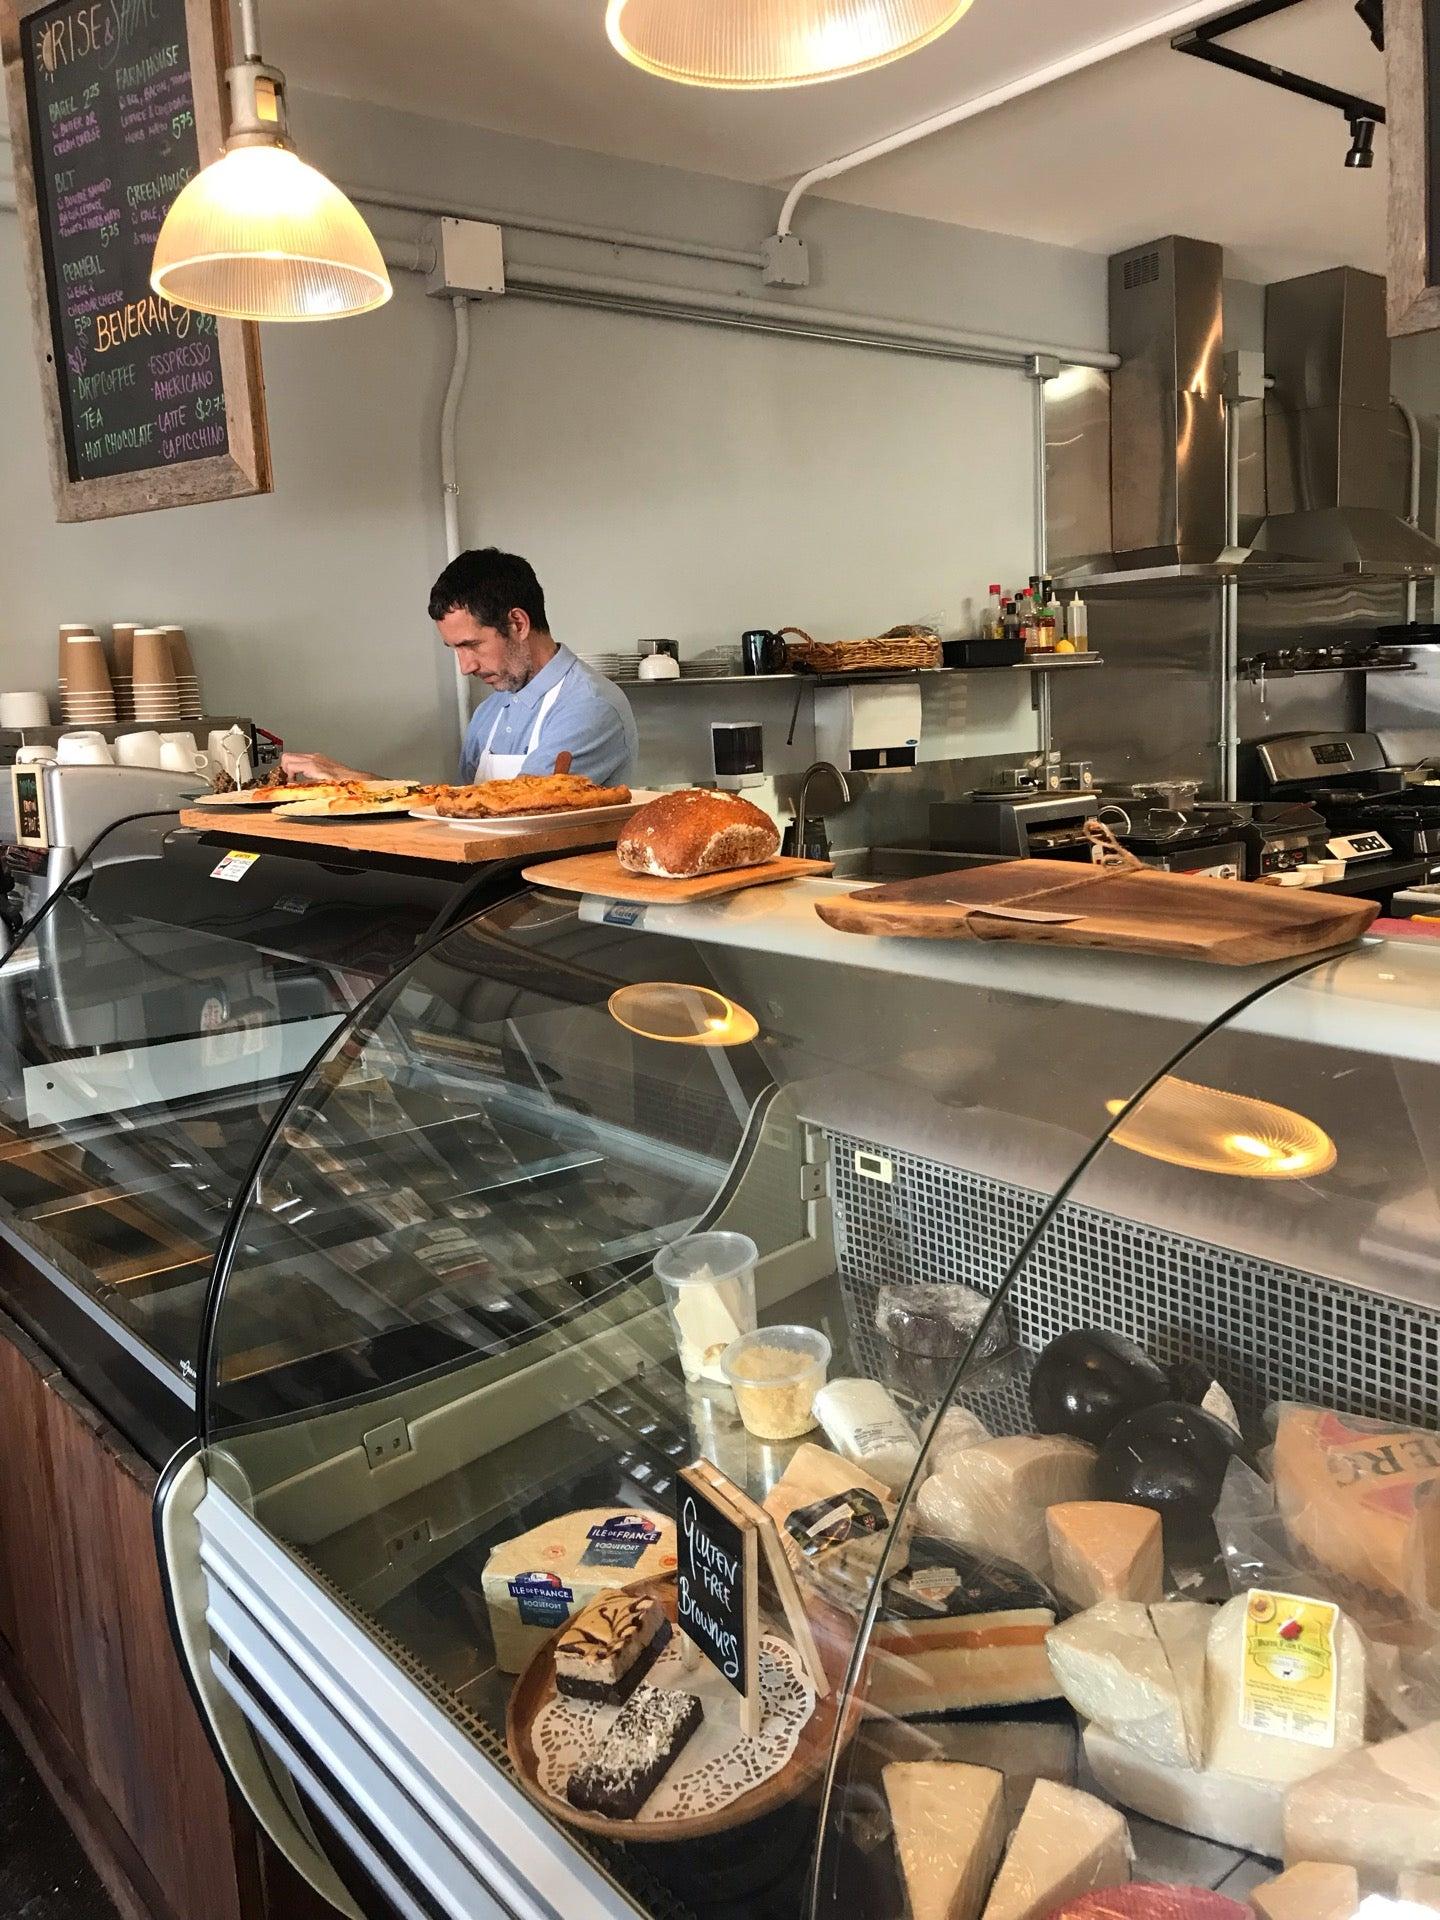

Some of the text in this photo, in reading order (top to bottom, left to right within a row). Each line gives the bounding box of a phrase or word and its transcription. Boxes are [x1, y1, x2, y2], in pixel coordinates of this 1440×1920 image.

[51, 3, 101, 70] RISE
[104, 16, 114, 46] &
[54, 169, 75, 193] BLT
[79, 406, 104, 432] TEA
[84, 422, 154, 463] HOT CHOCOLATE
[592, 1528, 606, 1537] ILE
[617, 1530, 657, 1541] FRANCE
[511, 1585, 526, 1595] ILE
[533, 1587, 569, 1598] FRANCE
